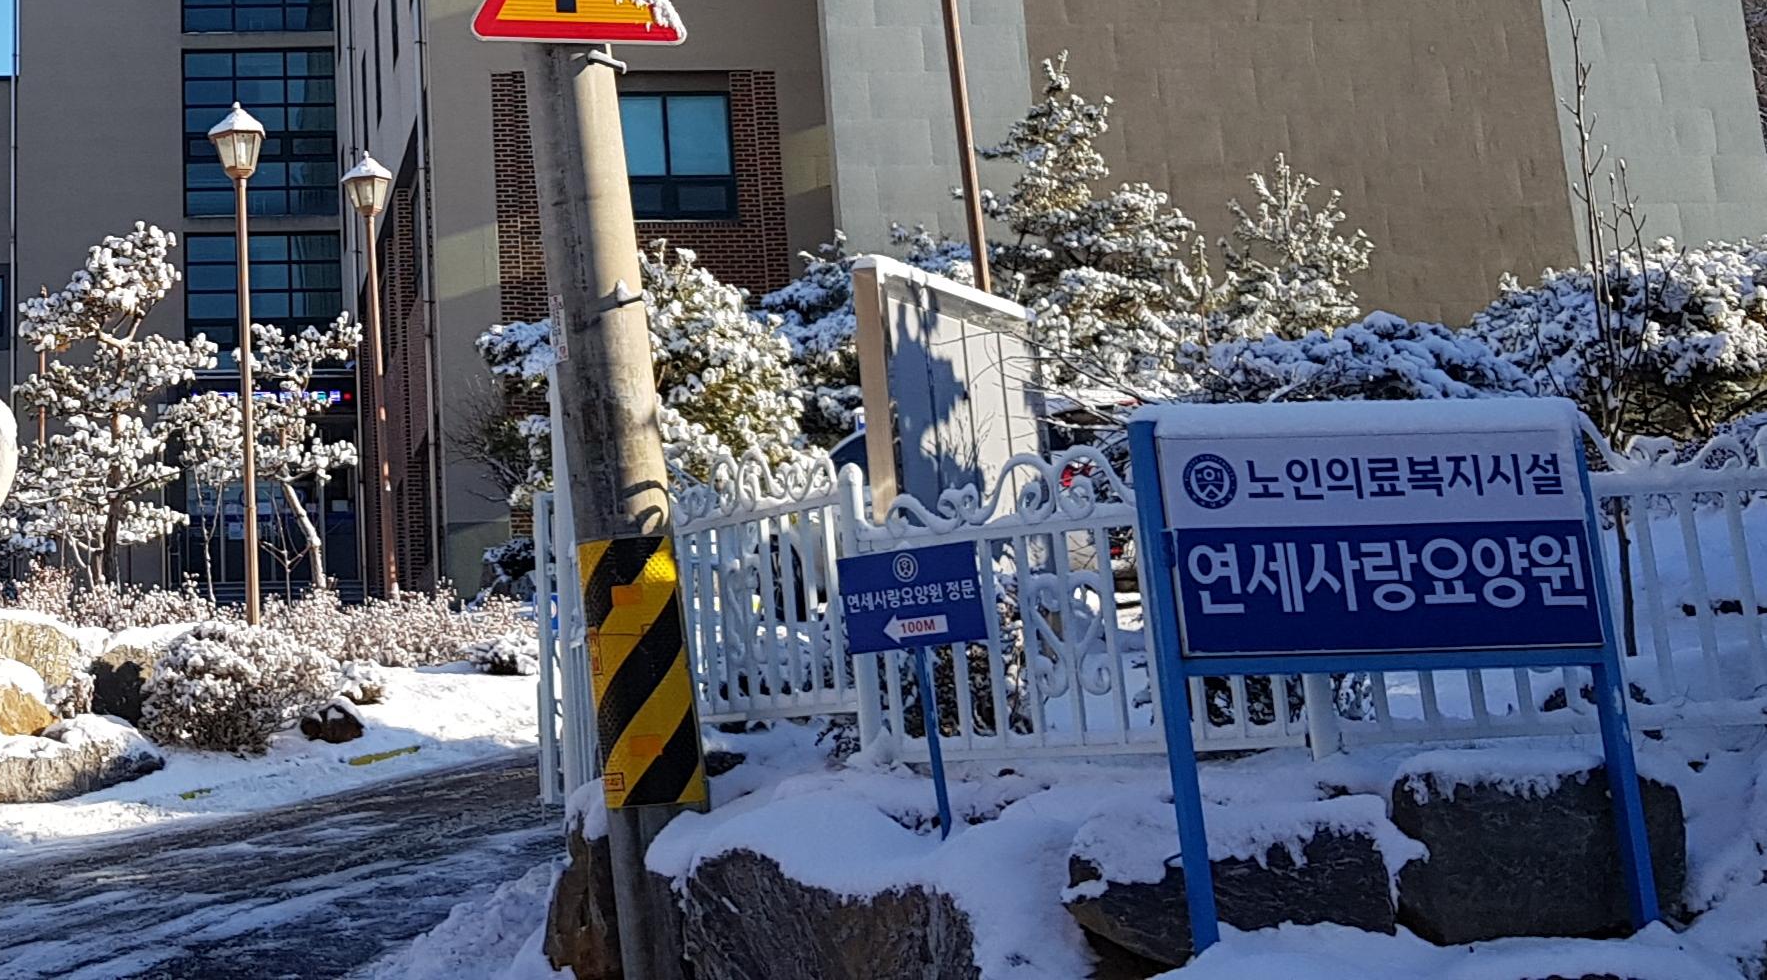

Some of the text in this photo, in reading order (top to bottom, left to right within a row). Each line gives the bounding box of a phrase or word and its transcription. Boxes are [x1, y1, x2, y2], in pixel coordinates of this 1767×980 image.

[1246, 453, 1565, 502] 노인의료복지시설
[1187, 534, 1589, 615] 연세사랑요양원
[846, 582, 944, 614] 연세사랑요양원
[900, 618, 937, 634] 100M
